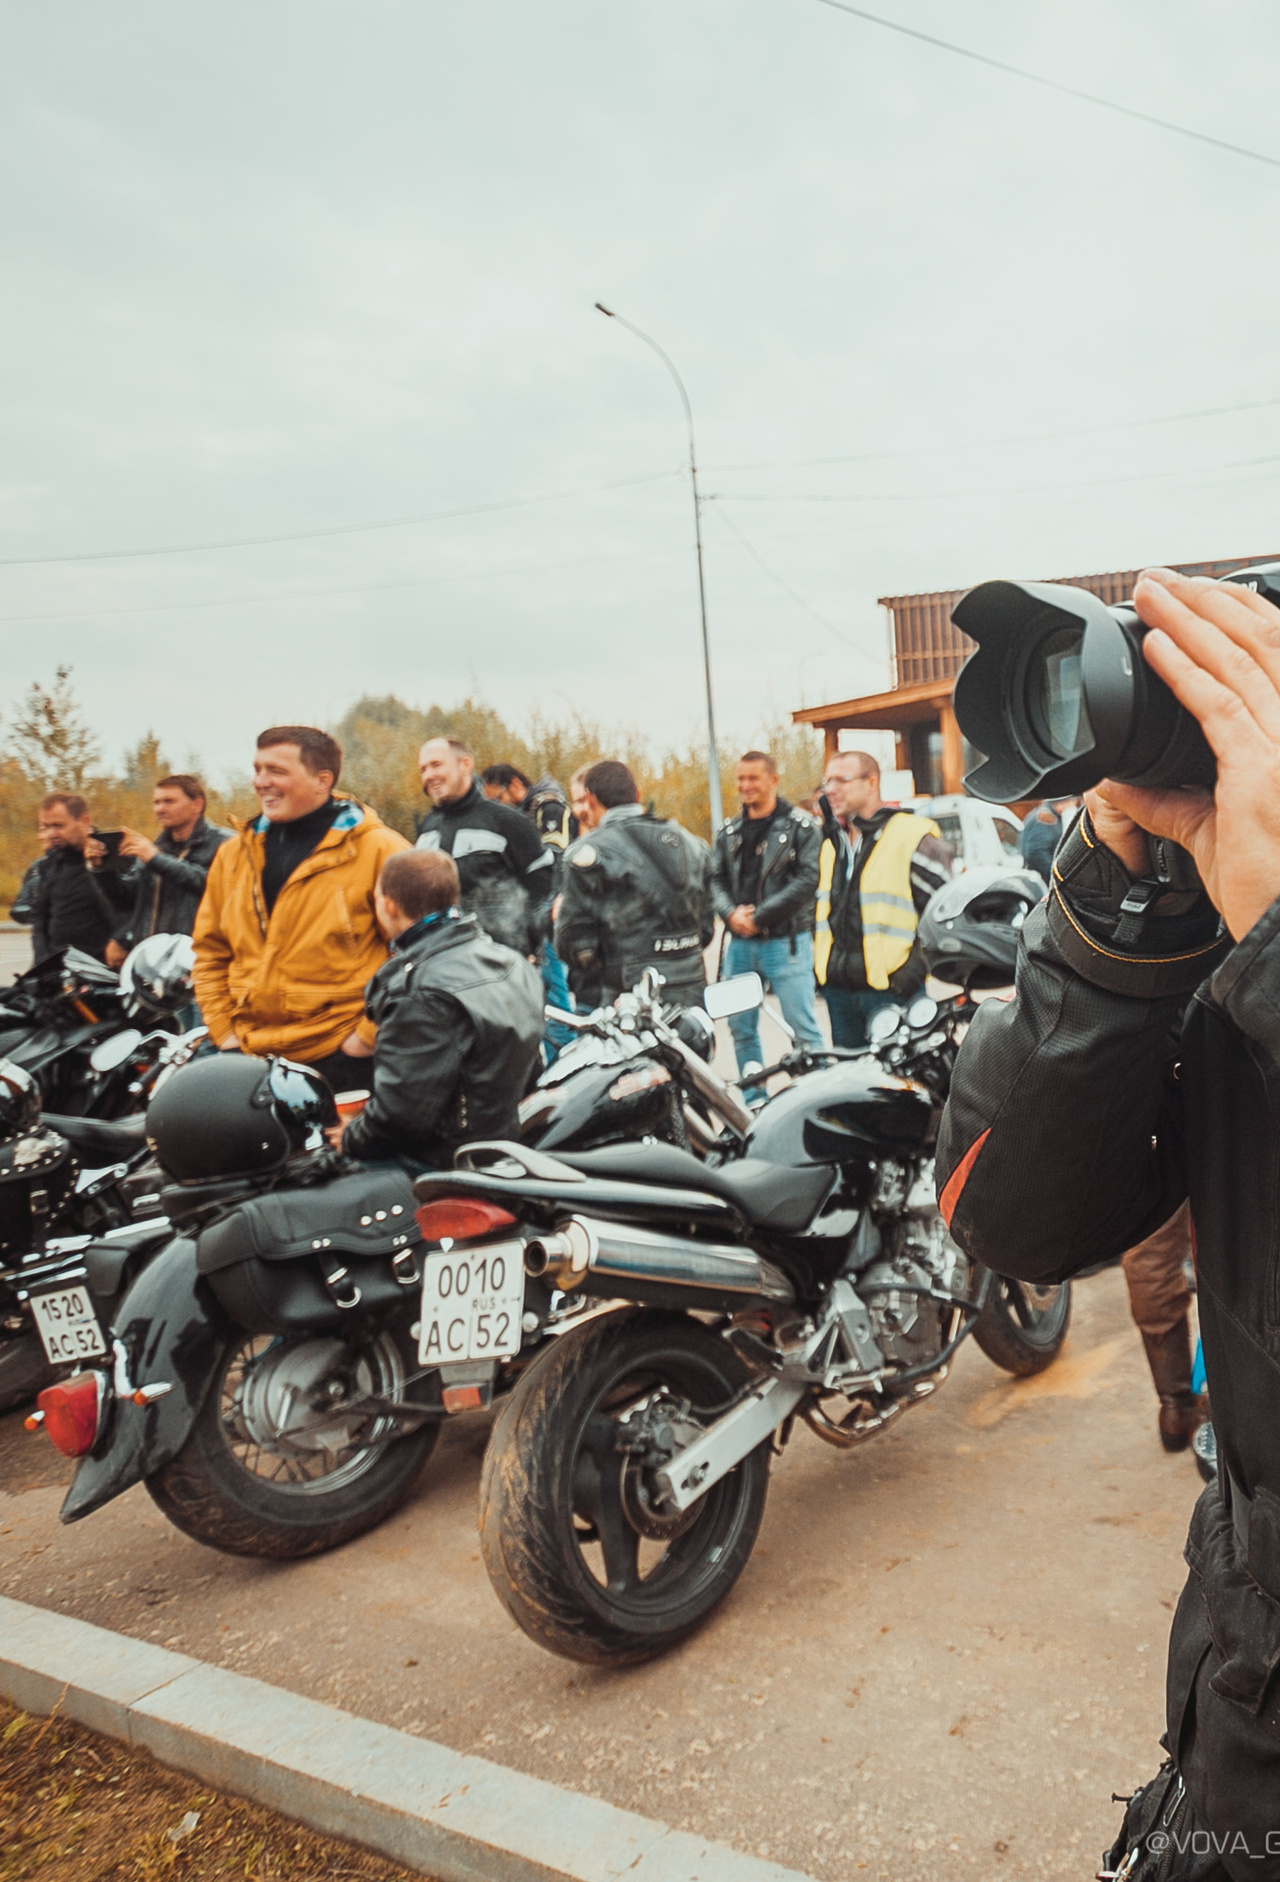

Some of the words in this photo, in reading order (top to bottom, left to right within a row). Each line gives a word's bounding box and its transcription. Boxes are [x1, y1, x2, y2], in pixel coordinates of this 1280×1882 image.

[438, 1257, 505, 1298] 0010
[41, 1293, 84, 1322] 1520
[48, 1334, 74, 1359] AC
[76, 1328, 100, 1352] 52
[425, 1317, 465, 1357] AC
[476, 1312, 509, 1348] 52
